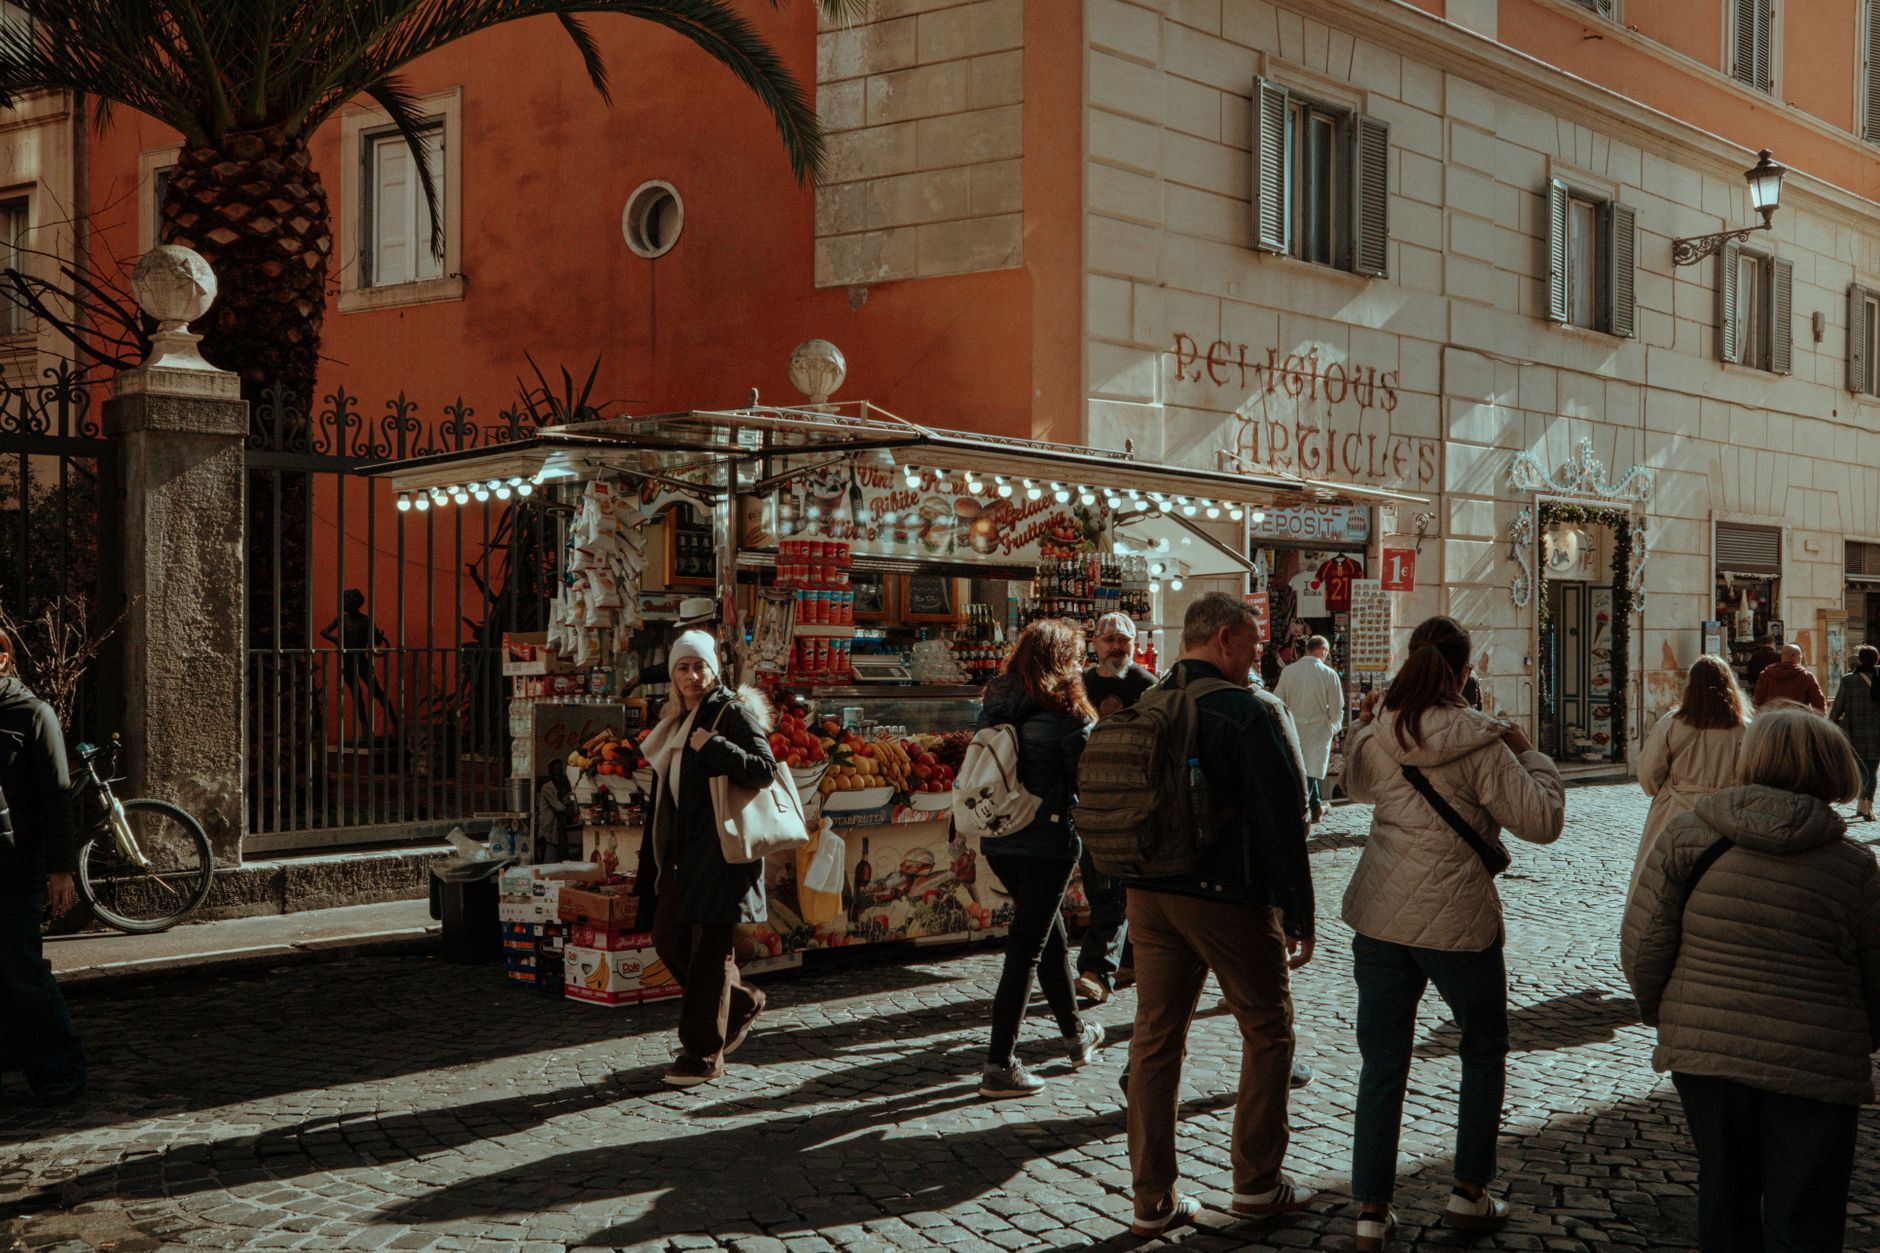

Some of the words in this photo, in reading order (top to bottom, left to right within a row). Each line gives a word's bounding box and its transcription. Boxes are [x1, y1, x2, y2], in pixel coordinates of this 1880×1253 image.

[1173, 332, 1399, 413] RELIGIOUS
[1233, 411, 1437, 486] ARTICLES
[857, 464, 894, 489] Vini
[870, 489, 919, 522] Bibite
[1002, 510, 1066, 556] Frutteria
[1331, 577, 1348, 600] 21
[622, 962, 641, 972] Dole
